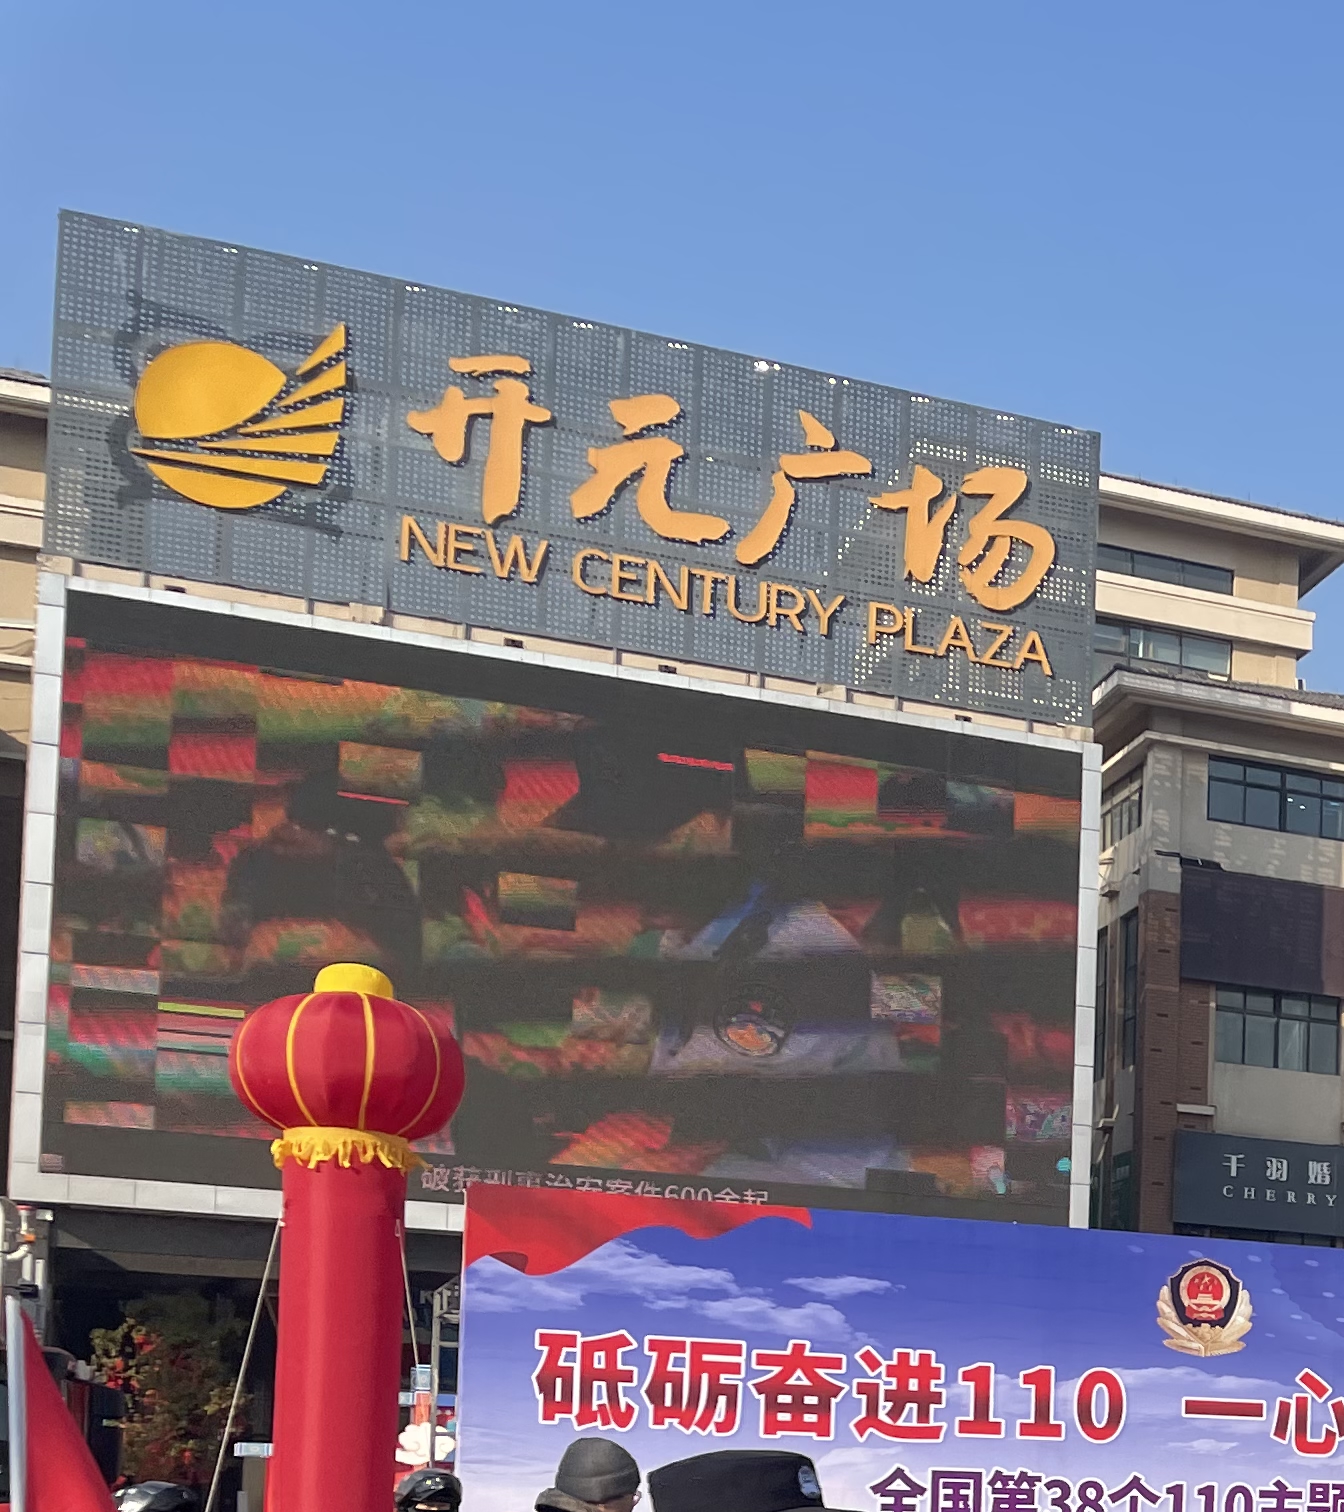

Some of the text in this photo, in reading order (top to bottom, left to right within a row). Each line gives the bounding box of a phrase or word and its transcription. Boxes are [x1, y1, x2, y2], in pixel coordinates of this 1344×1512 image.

[406, 354, 1056, 612] 开元广场
[399, 514, 1052, 677] NEW CENTURY PLAZA
[1222, 1185, 1337, 1207] CHERRY
[532, 1328, 1127, 1443] 砥砺奋进110
